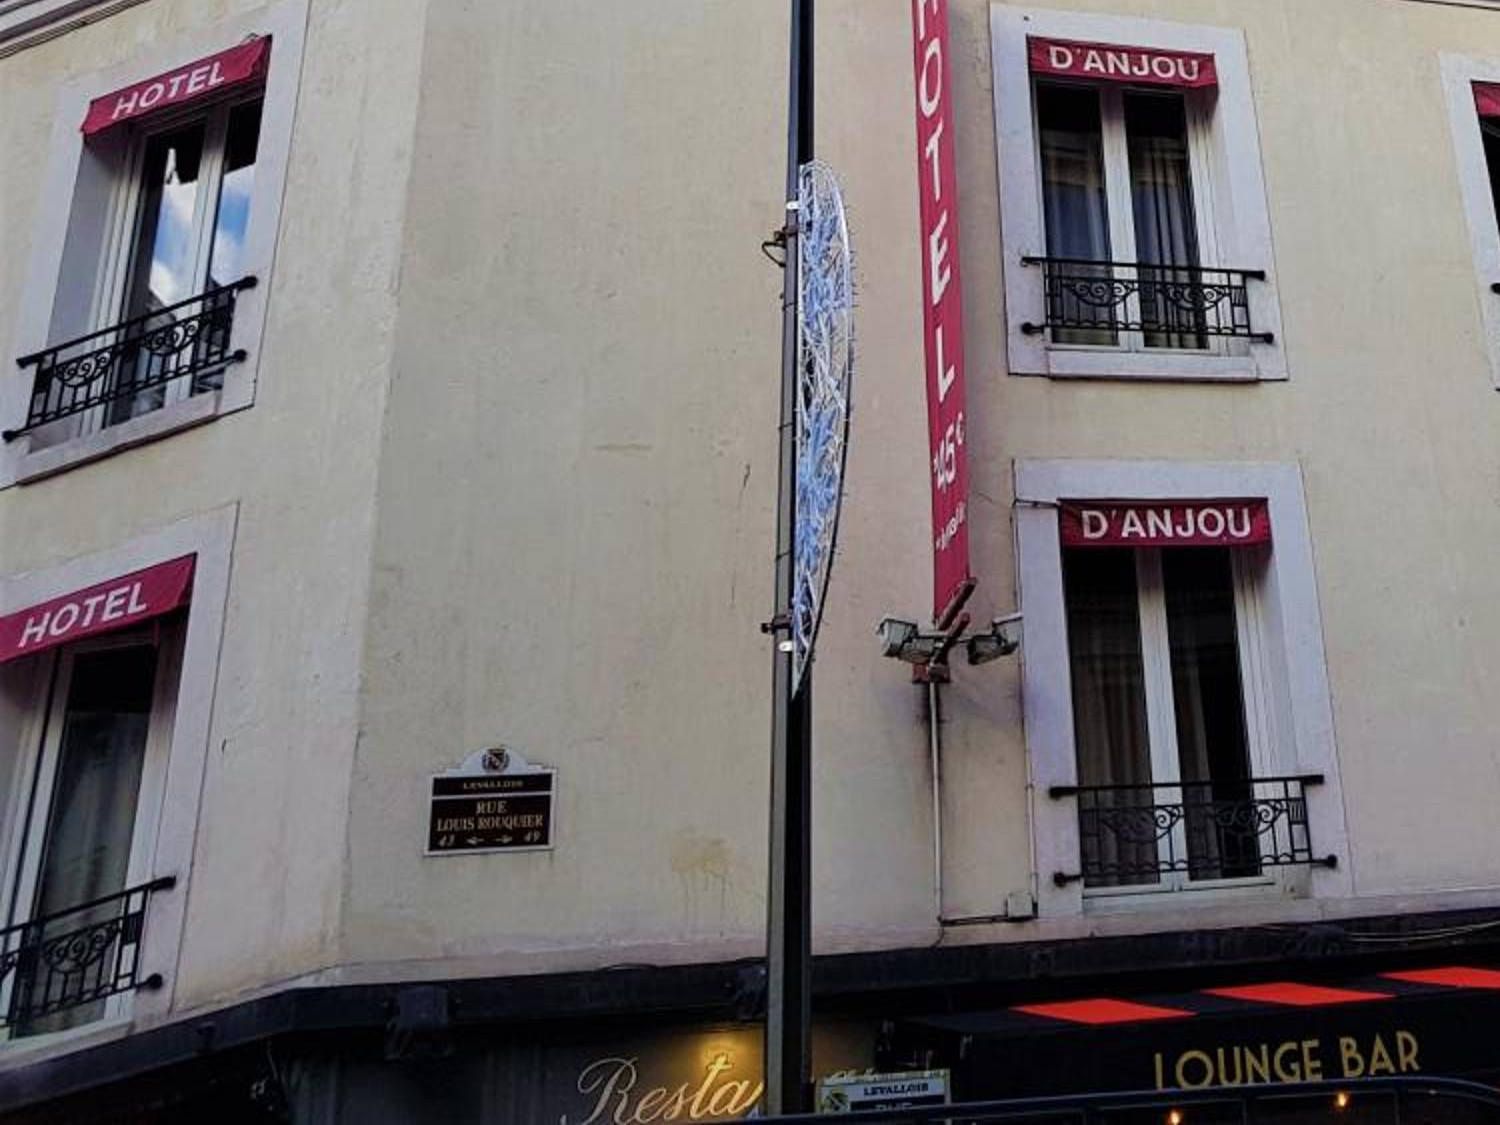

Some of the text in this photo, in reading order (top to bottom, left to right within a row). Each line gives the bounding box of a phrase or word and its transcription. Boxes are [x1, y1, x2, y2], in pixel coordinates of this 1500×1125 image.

[1050, 46, 1198, 80] D'ANJOU
[111, 62, 224, 119] HOTEL
[1082, 508, 1250, 538] D'ANJOU
[18, 582, 146, 647] HOTEL
[476, 800, 507, 814] RUE
[437, 817, 475, 832] LOUIS
[1154, 1030, 1421, 1092] LOUNGE BAR
